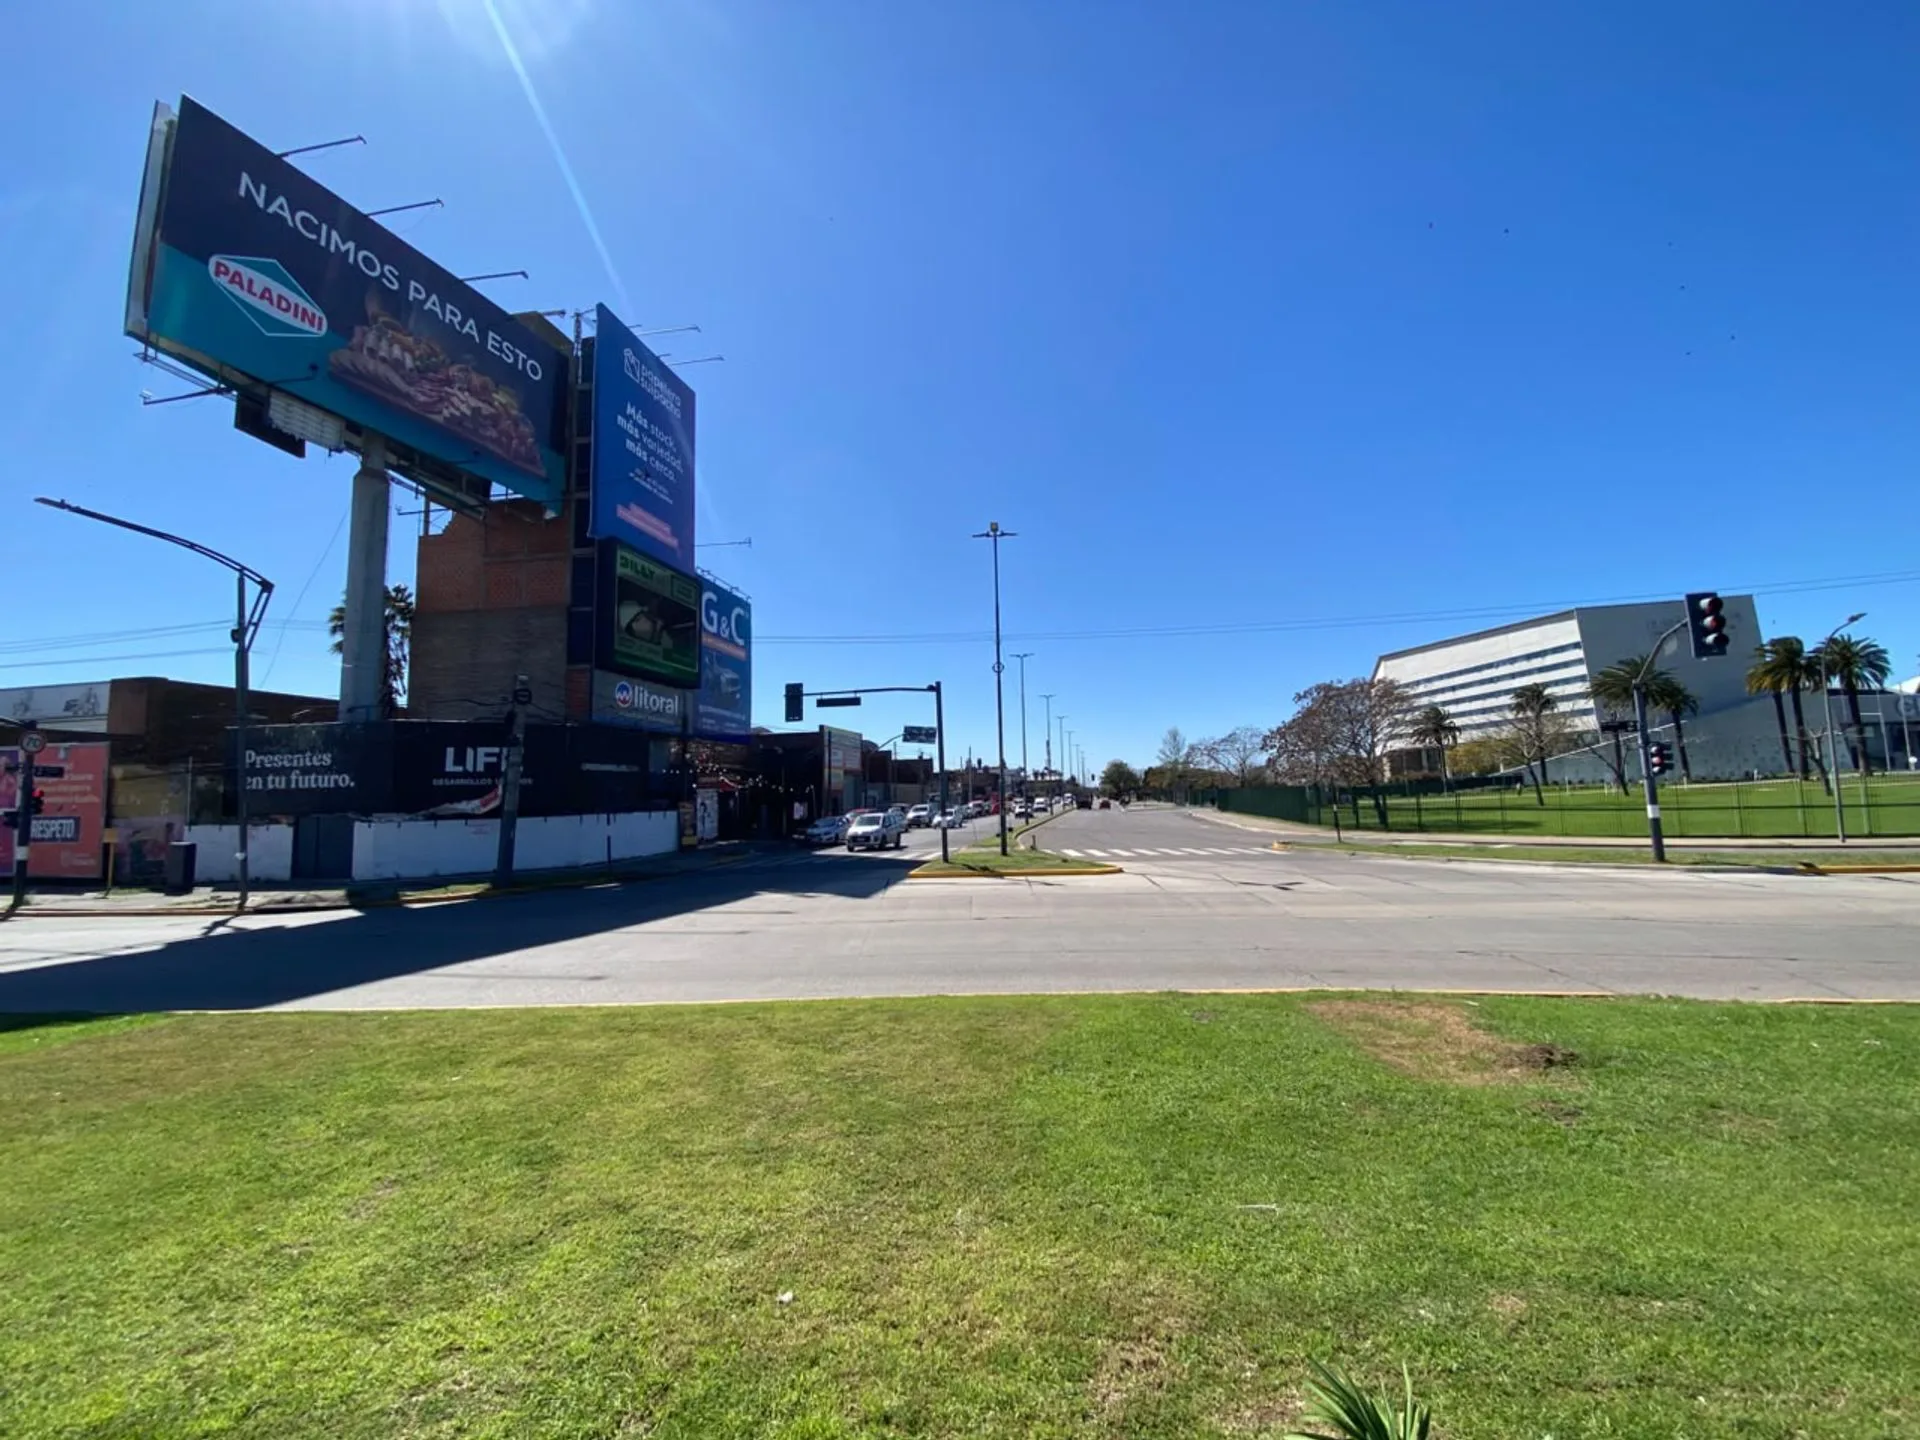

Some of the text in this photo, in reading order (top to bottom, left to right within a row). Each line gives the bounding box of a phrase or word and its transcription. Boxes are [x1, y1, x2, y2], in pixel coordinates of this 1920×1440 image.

[238, 171, 542, 381] NACIMOS PARA ESTO
[214, 260, 323, 332] PALADINI
[616, 413, 641, 439] más
[626, 400, 649, 430] Más
[625, 437, 648, 462] más
[701, 591, 746, 647] G&C
[633, 684, 680, 717] litoral
[244, 749, 333, 769] Presentes
[266, 773, 287, 790] tu
[290, 769, 356, 789] futuro.
